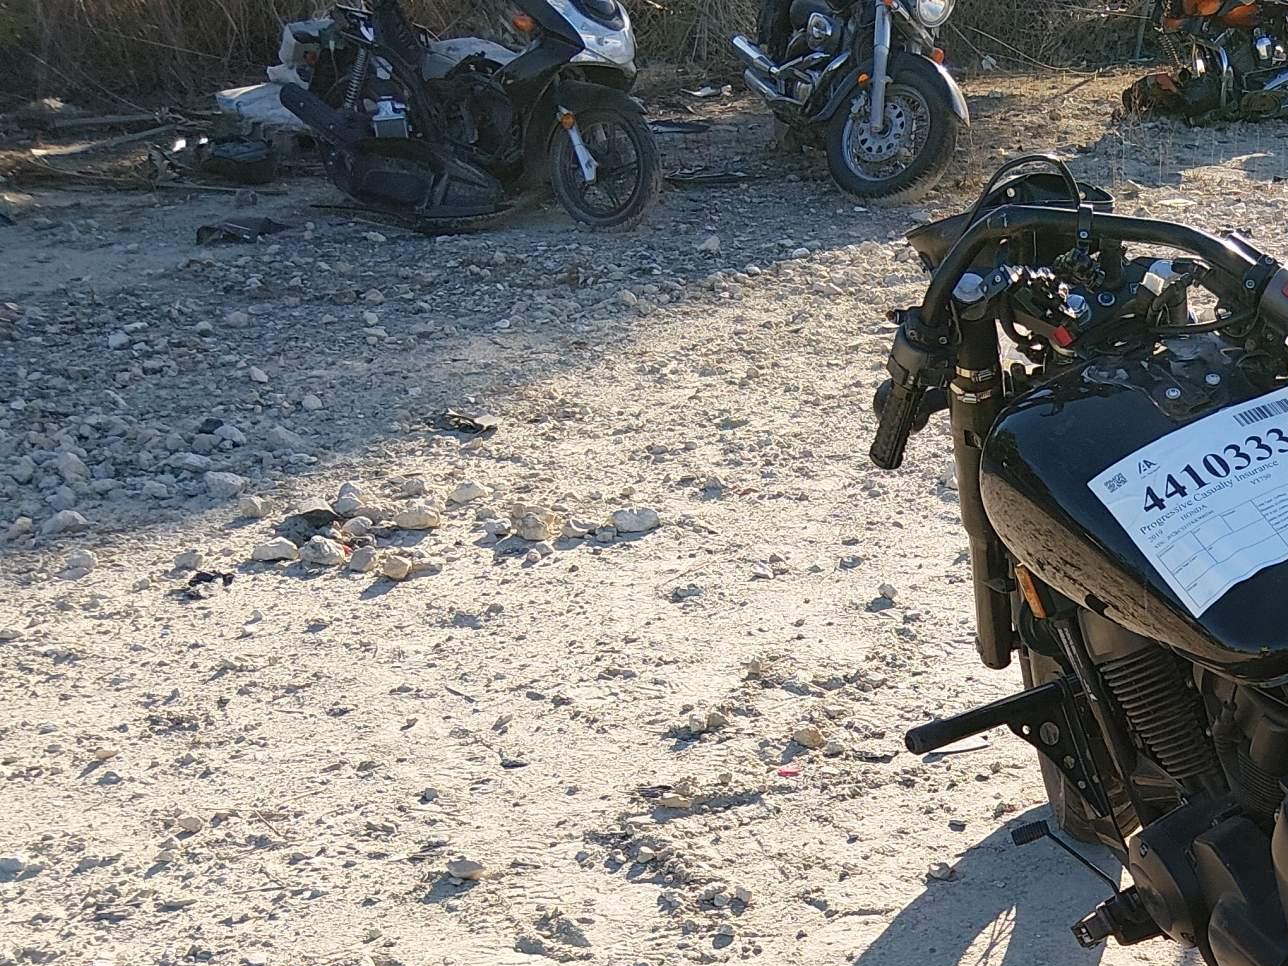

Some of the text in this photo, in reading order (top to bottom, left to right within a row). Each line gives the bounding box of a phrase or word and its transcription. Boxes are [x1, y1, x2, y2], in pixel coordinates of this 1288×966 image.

[1139, 500, 1194, 535] Progressive
[1193, 479, 1234, 503] Casualty
[1234, 459, 1279, 483] Insurance
[1180, 504, 1208, 521] HONDA
